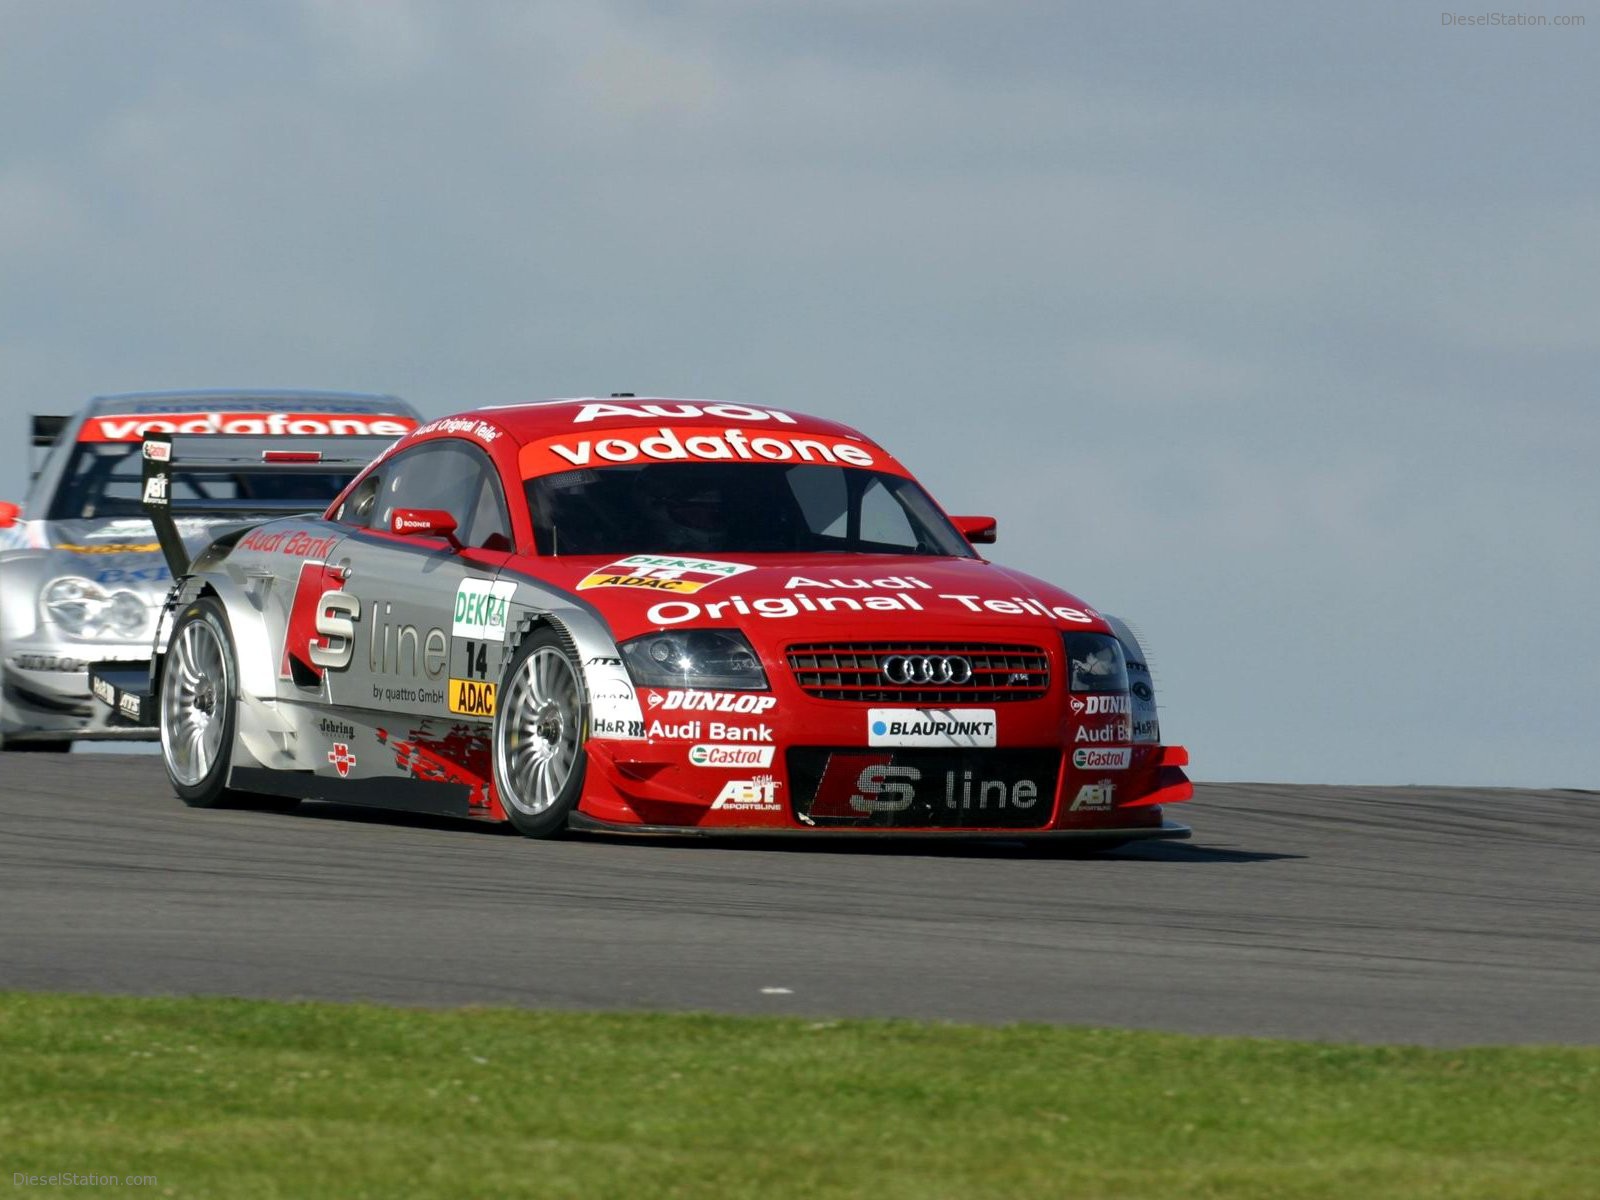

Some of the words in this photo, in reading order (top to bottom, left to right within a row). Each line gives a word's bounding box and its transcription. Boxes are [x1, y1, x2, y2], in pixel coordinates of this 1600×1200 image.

[572, 404, 798, 424] Audi
[100, 413, 408, 439] vodafone
[439, 418, 478, 434] Original
[549, 428, 874, 467] vodafone
[240, 528, 289, 553] Audi
[284, 531, 336, 559] Bank
[622, 556, 738, 574] DEKRA
[598, 575, 684, 590] ADAC
[784, 576, 933, 590] Audi
[454, 591, 506, 628] DEKRA
[647, 592, 925, 626] Original
[308, 589, 361, 673] S
[369, 600, 448, 681] line
[466, 641, 488, 680] 14
[373, 685, 384, 701] by
[385, 687, 416, 705] quattro
[418, 689, 444, 704] GmbH
[458, 682, 493, 714] ADAC
[662, 690, 777, 714] DUNLOP
[1085, 696, 1131, 715] DUNL
[594, 717, 625, 733] H&R
[648, 719, 701, 739] Audi
[709, 722, 773, 742] Bank
[889, 721, 993, 736] BLAUPUNKT
[1074, 725, 1113, 743] Audi
[708, 748, 763, 764] Castrol
[1087, 751, 1124, 766] Castrol
[710, 780, 774, 810] ABT
[849, 764, 922, 812] S
[946, 771, 1038, 809] line
[1069, 784, 1114, 812] ABT
[721, 803, 782, 811] SPORTSLINE
